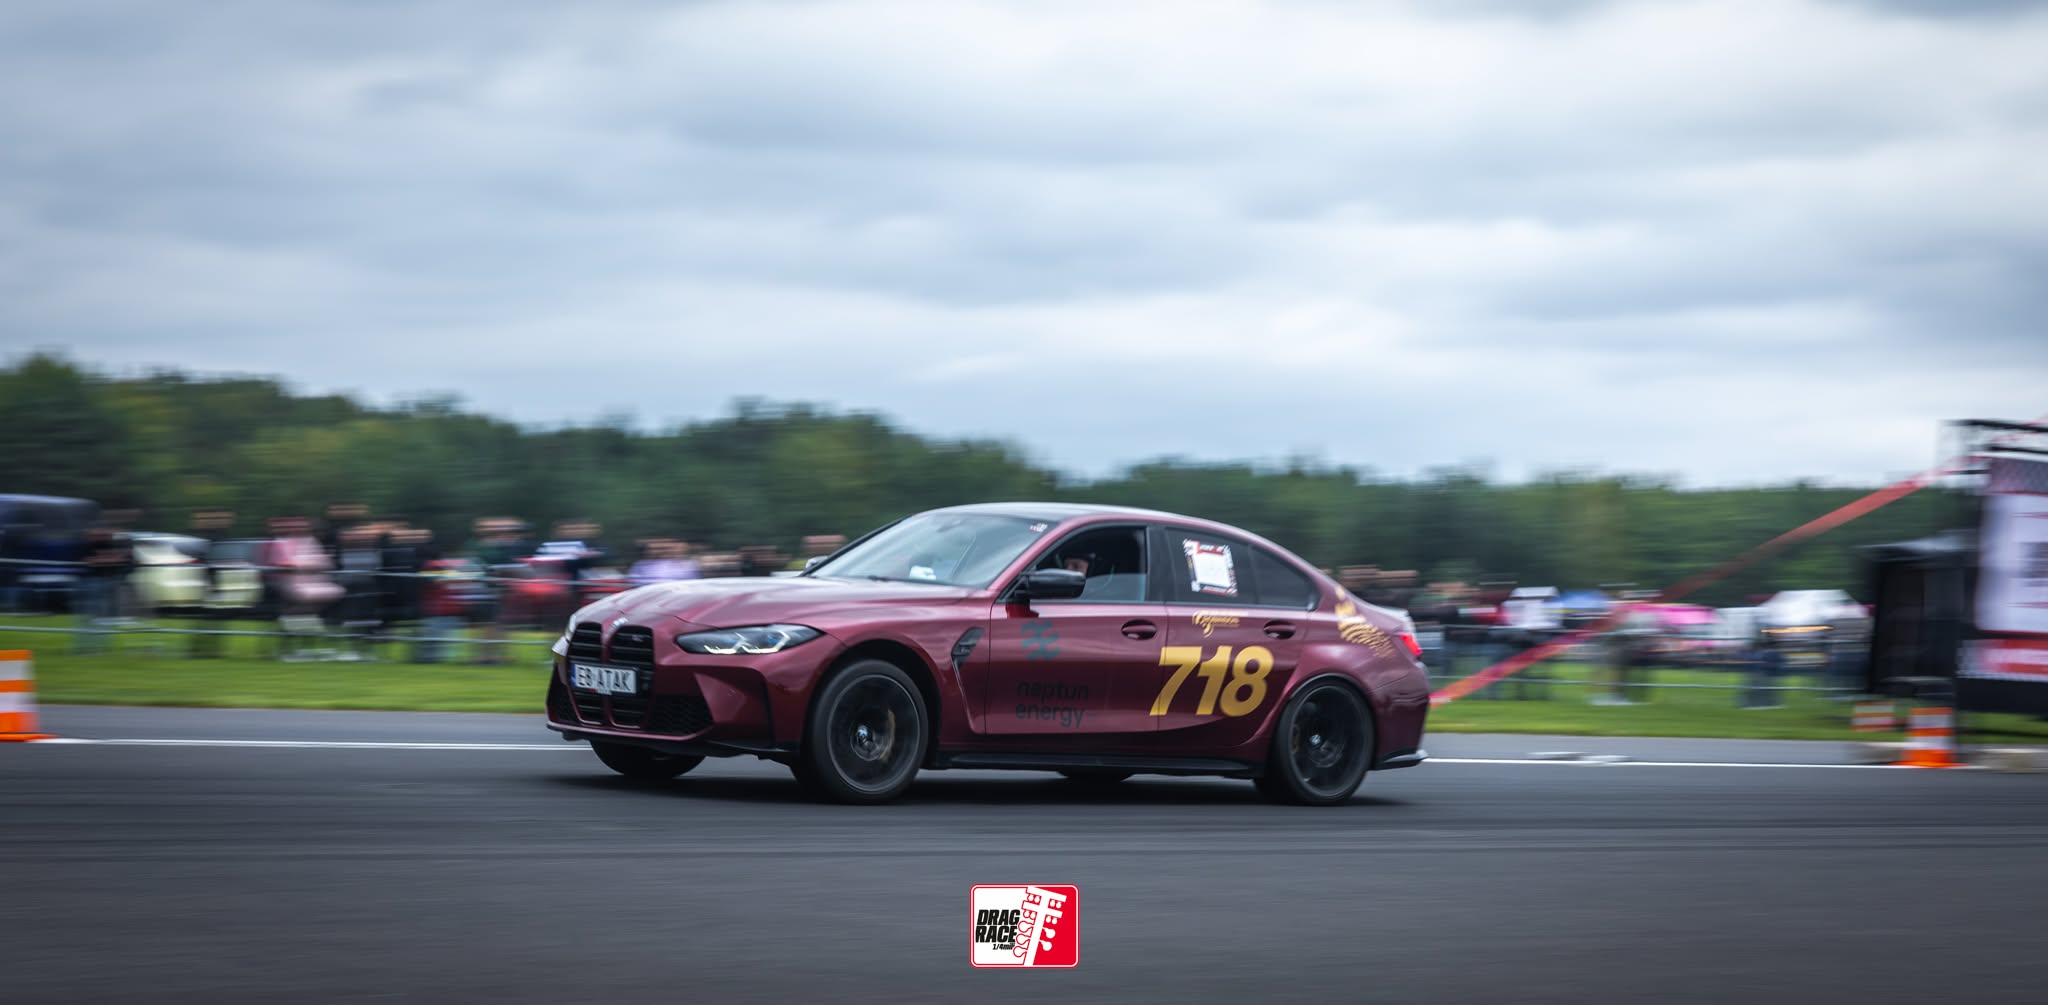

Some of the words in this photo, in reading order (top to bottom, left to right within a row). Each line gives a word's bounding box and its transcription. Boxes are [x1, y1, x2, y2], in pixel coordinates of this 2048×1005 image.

[597, 669, 631, 692] ATAK
[1149, 645, 1274, 717] 718
[1015, 703, 1085, 728] energy
